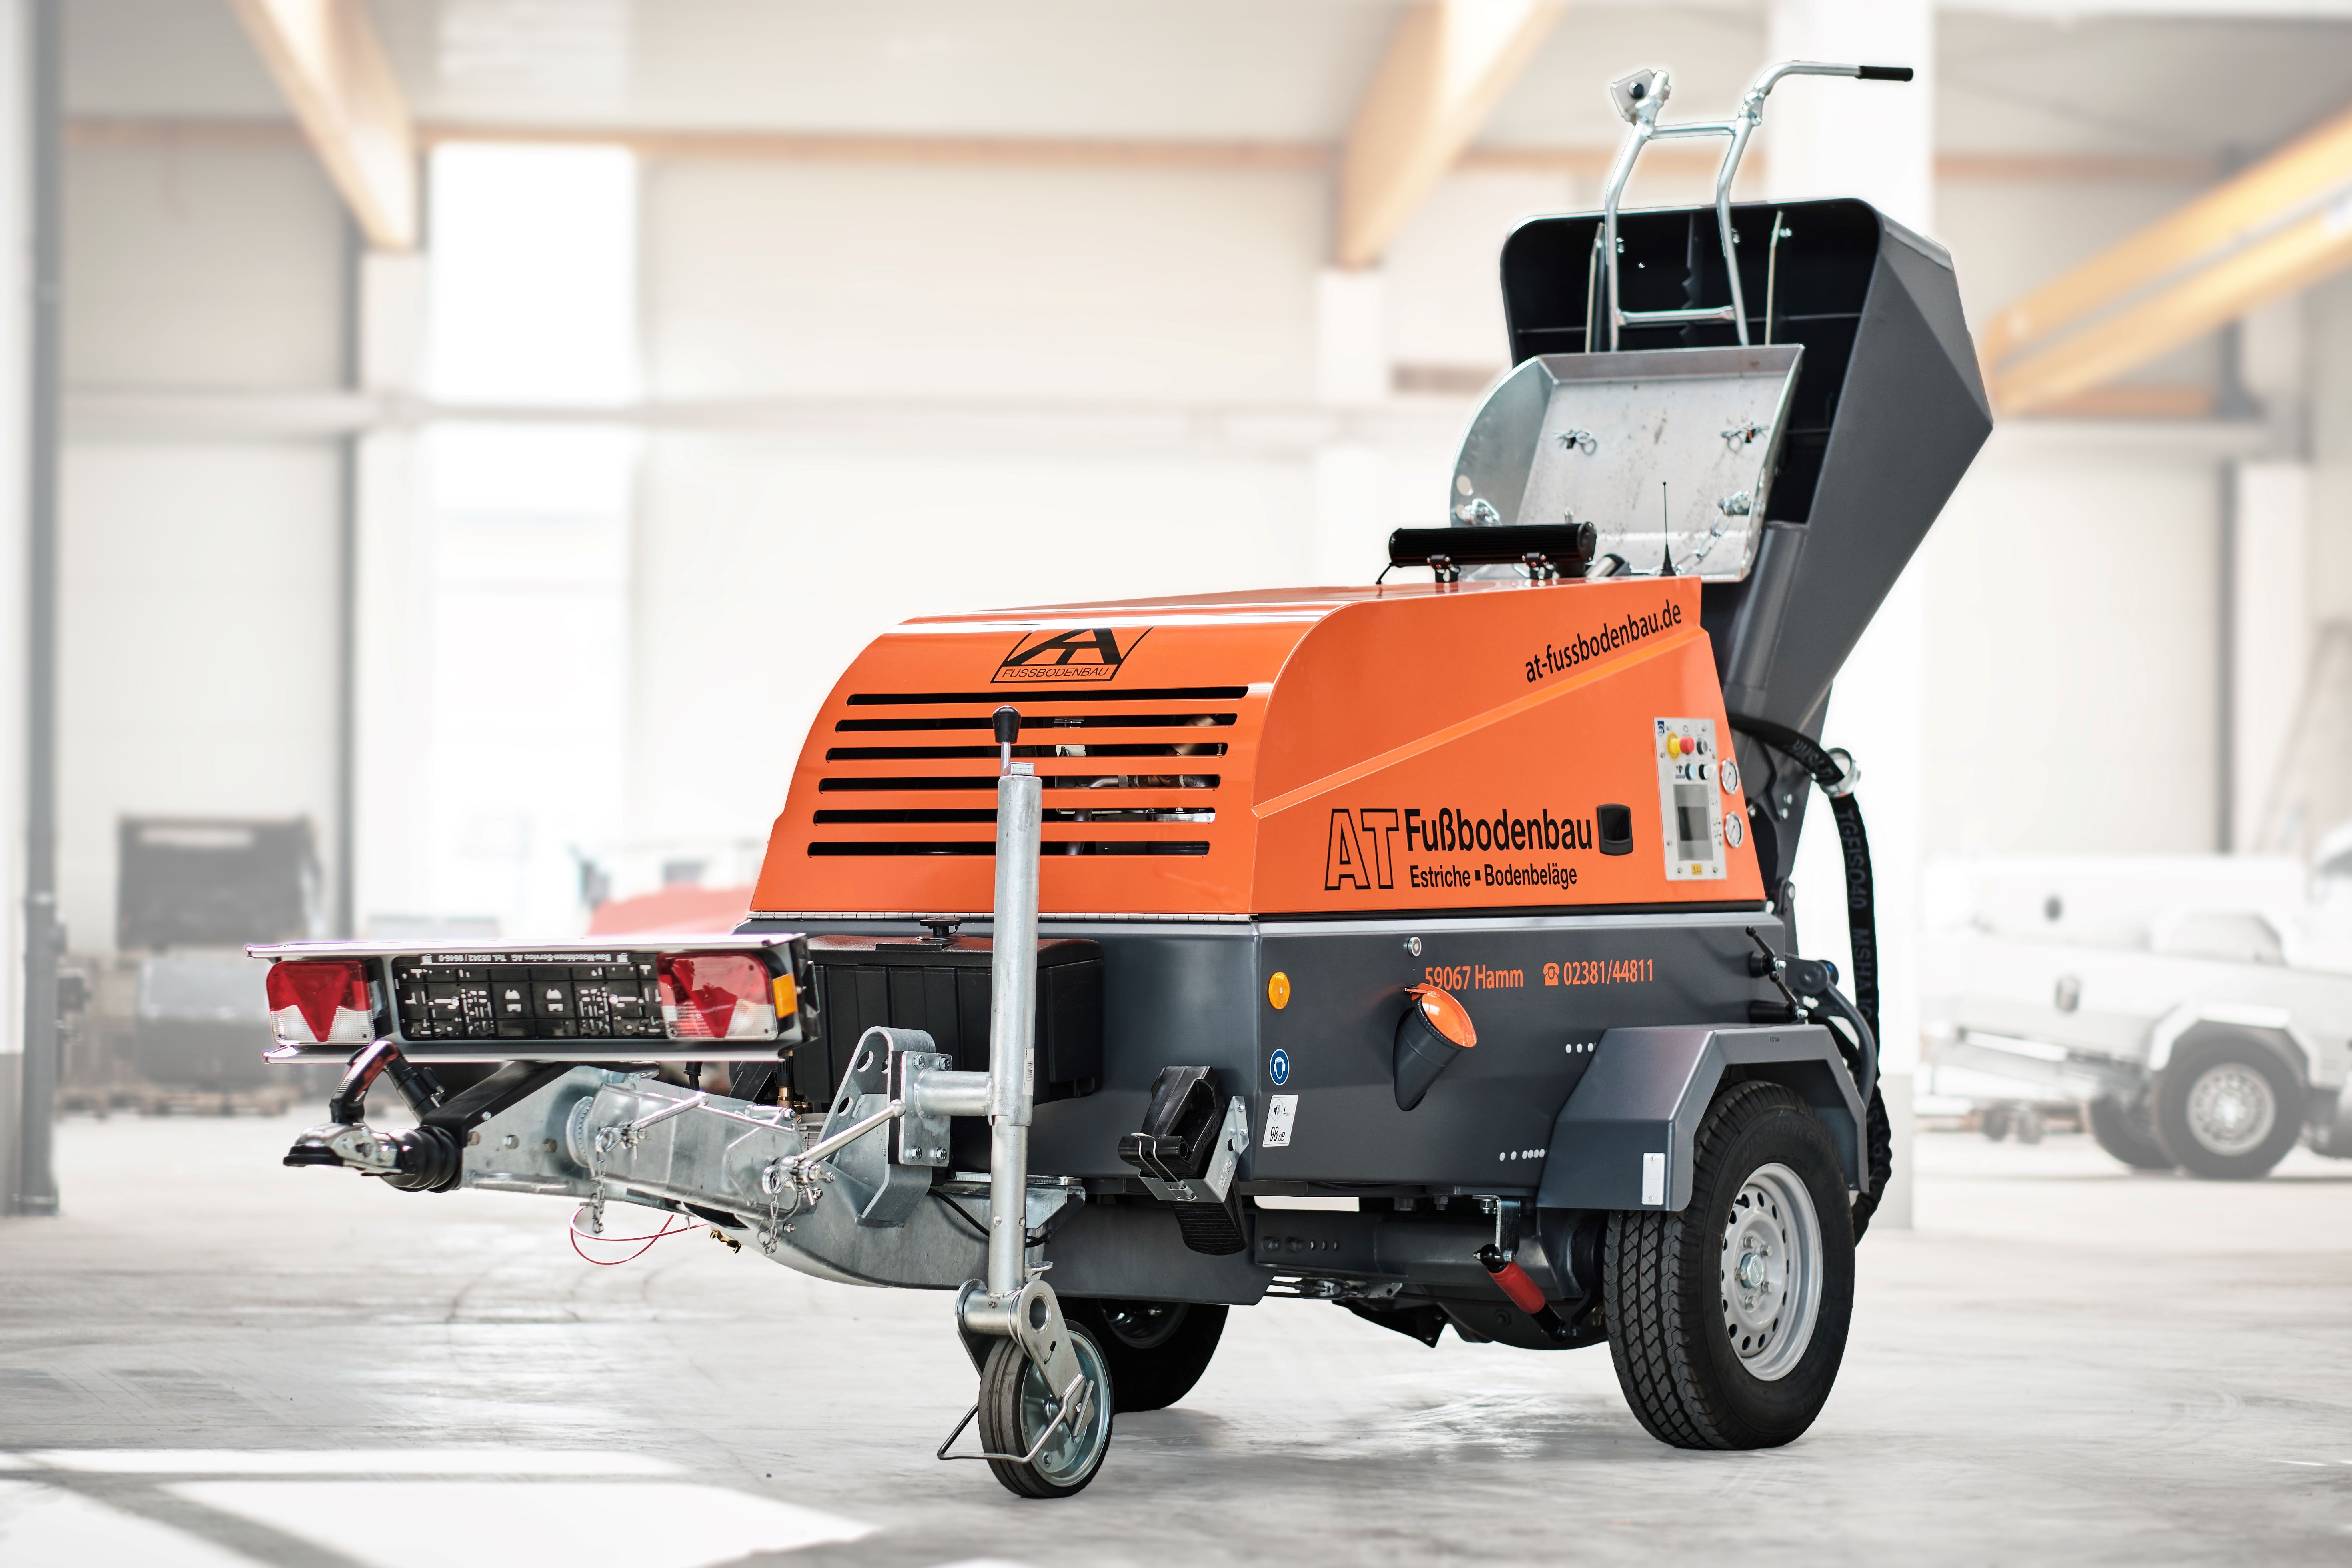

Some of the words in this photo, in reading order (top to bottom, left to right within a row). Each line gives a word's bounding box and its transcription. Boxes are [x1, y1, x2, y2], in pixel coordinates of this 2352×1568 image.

[1525, 599, 1681, 683] at-fussbodenbau.de
[1002, 667, 1109, 677] FUSSBODENBAU
[1325, 808, 1399, 890] AT
[1405, 807, 1592, 851] Fußbodenbau
[1410, 865, 1471, 888] Estriche
[1485, 863, 1577, 890] Bodenbeläge
[1425, 965, 1471, 991] 59067
[1475, 964, 1523, 989] Hamm
[1563, 959, 1653, 985] 02381/44811
[1852, 927, 1872, 991] MSHA
[1270, 1126, 1279, 1142] 98
[1278, 1132, 1285, 1141] dB
